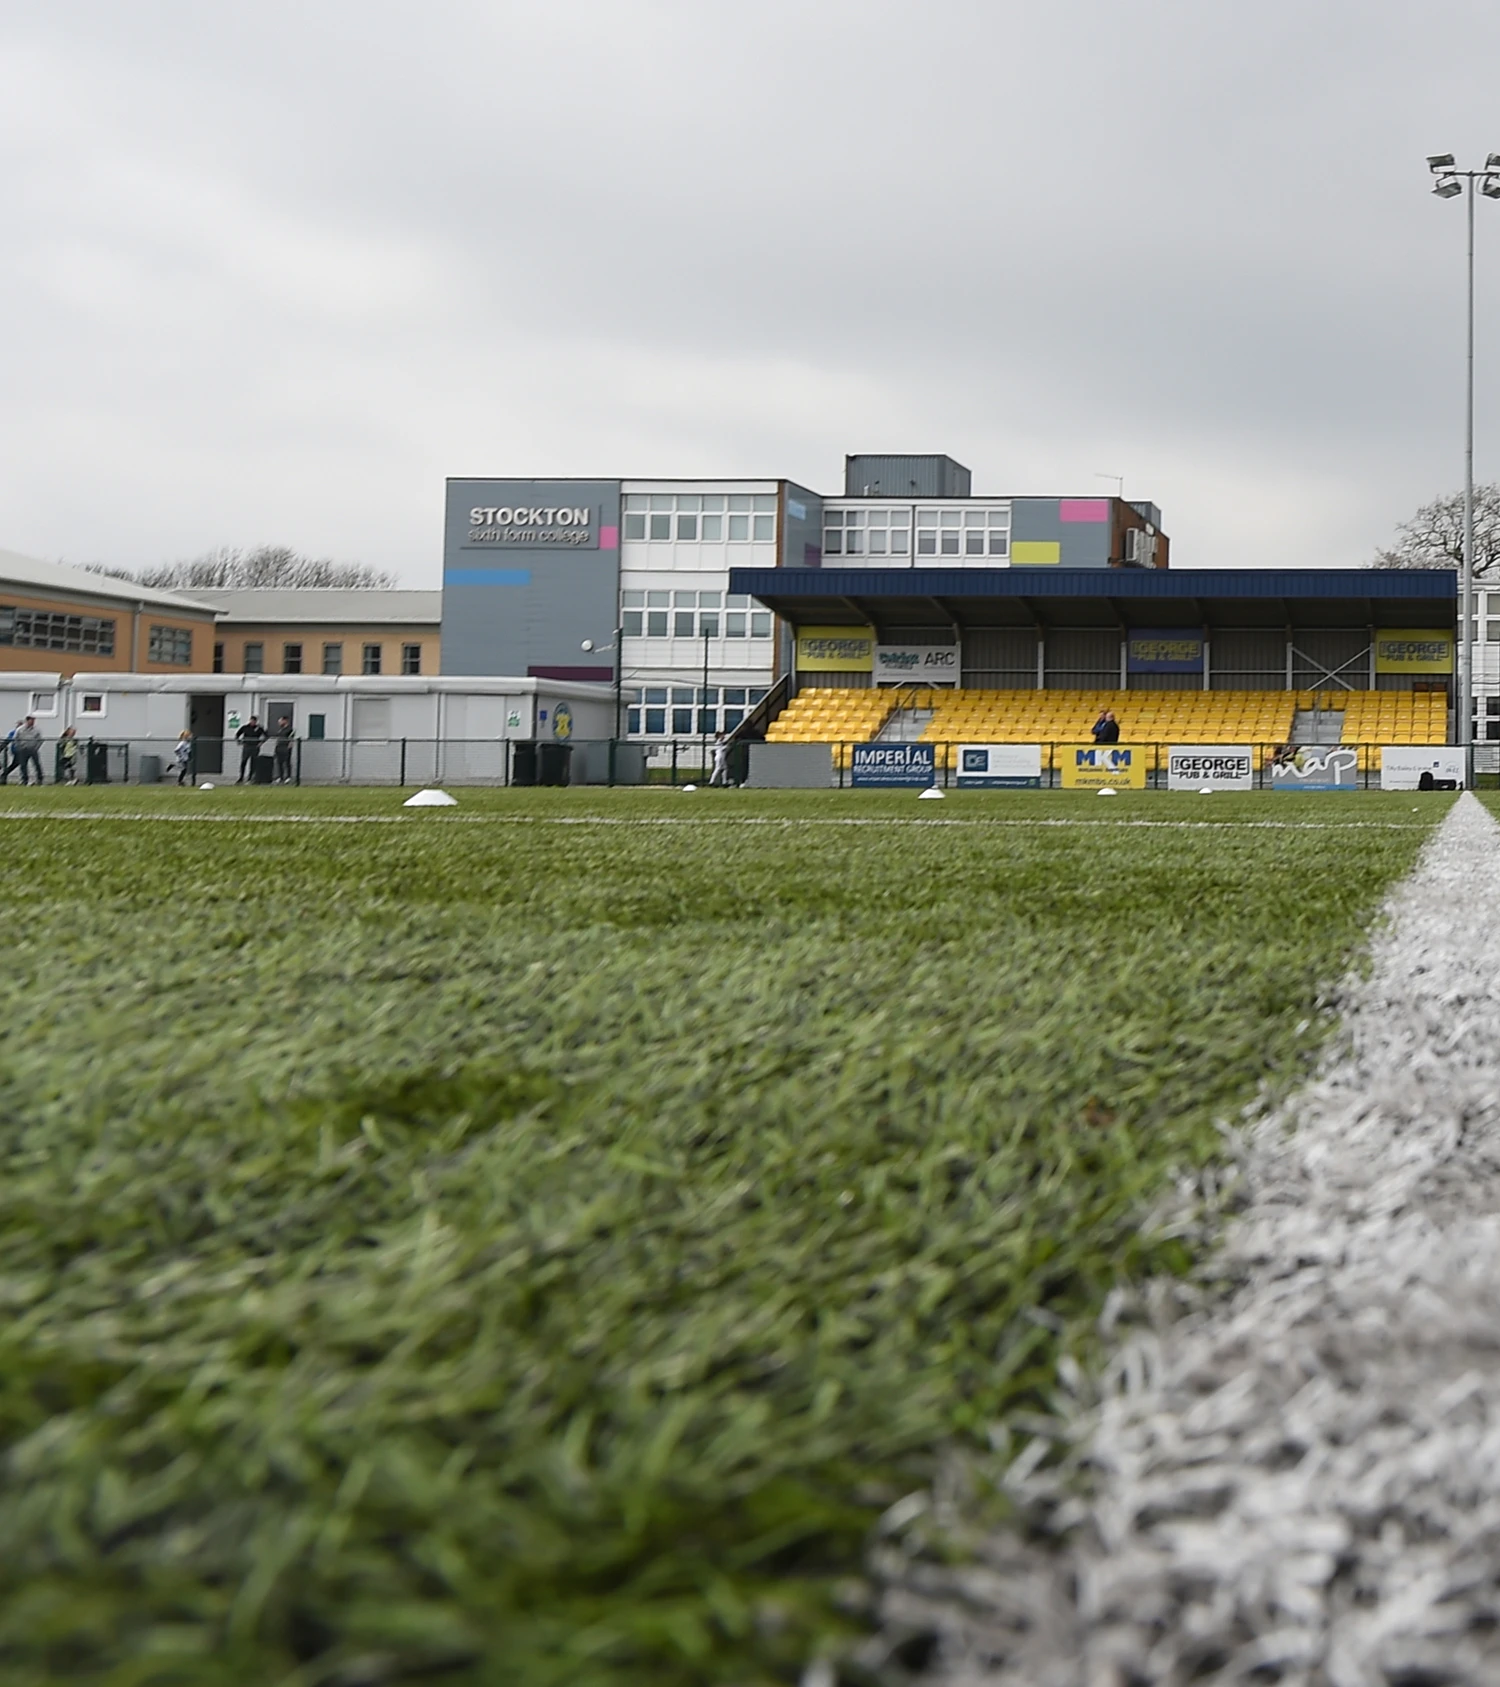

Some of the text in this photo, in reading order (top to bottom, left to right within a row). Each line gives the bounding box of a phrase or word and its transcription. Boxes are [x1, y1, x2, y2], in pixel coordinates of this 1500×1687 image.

[469, 506, 590, 526] STOCKTON
[468, 527, 590, 546] sixth form college
[808, 639, 867, 652] GEORGE
[1140, 642, 1198, 654] GEORGE
[1387, 643, 1446, 654] GEORGE
[924, 651, 956, 666] ARC
[855, 746, 931, 765] IMPERIAL
[1076, 749, 1132, 774] MKM
[853, 765, 933, 774] RECRUITMENT GROUP
[1180, 758, 1247, 771] GEORGE
[1271, 750, 1357, 786] map
[1179, 770, 1242, 780] PUB & GRILL
